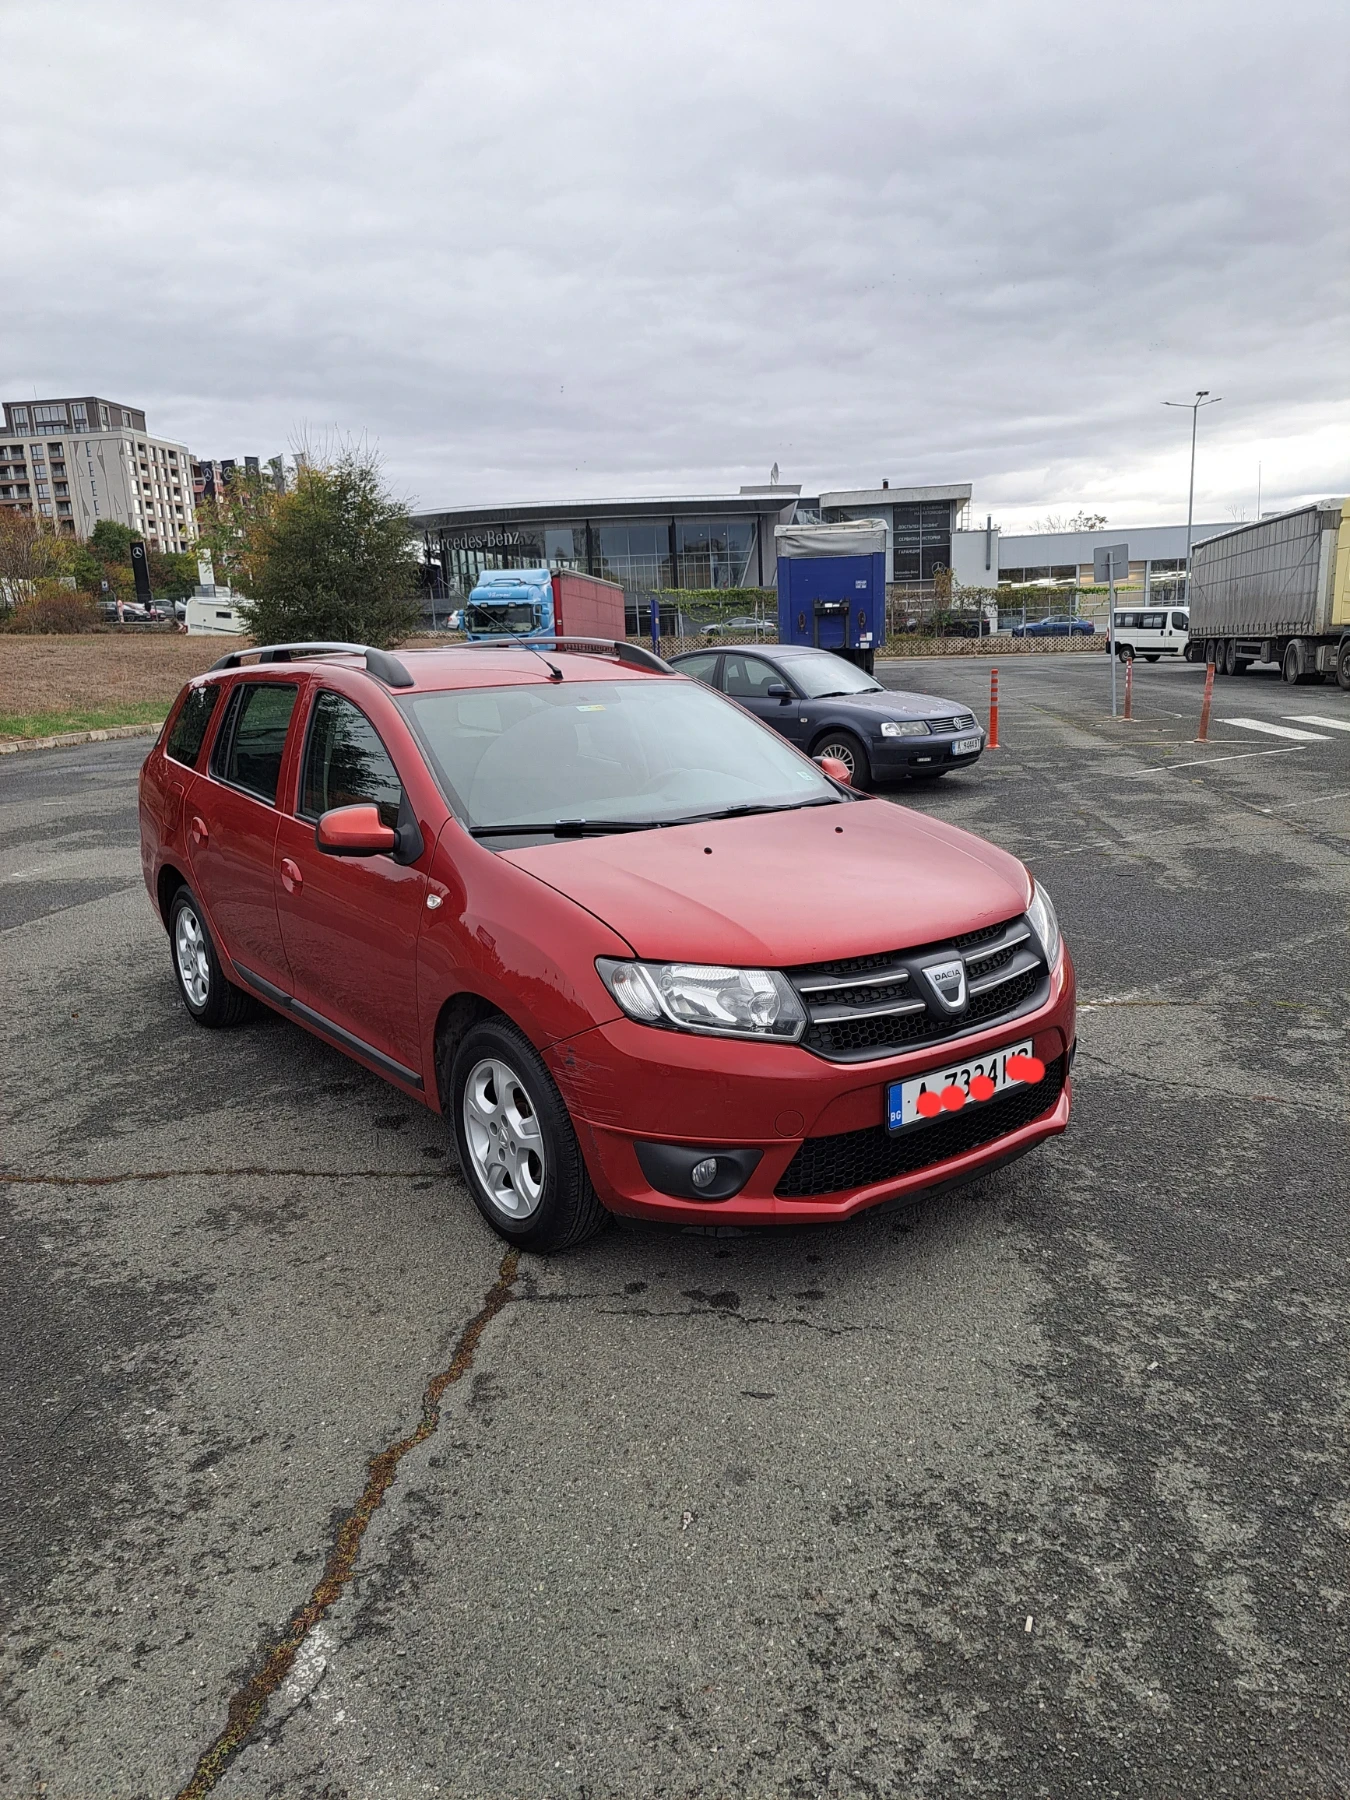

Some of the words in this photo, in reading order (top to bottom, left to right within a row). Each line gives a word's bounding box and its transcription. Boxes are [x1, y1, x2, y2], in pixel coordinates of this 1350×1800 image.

[424, 530, 520, 551] Mercedes-Benz
[934, 969, 961, 981] DACIA
[890, 1110, 902, 1122] BG
